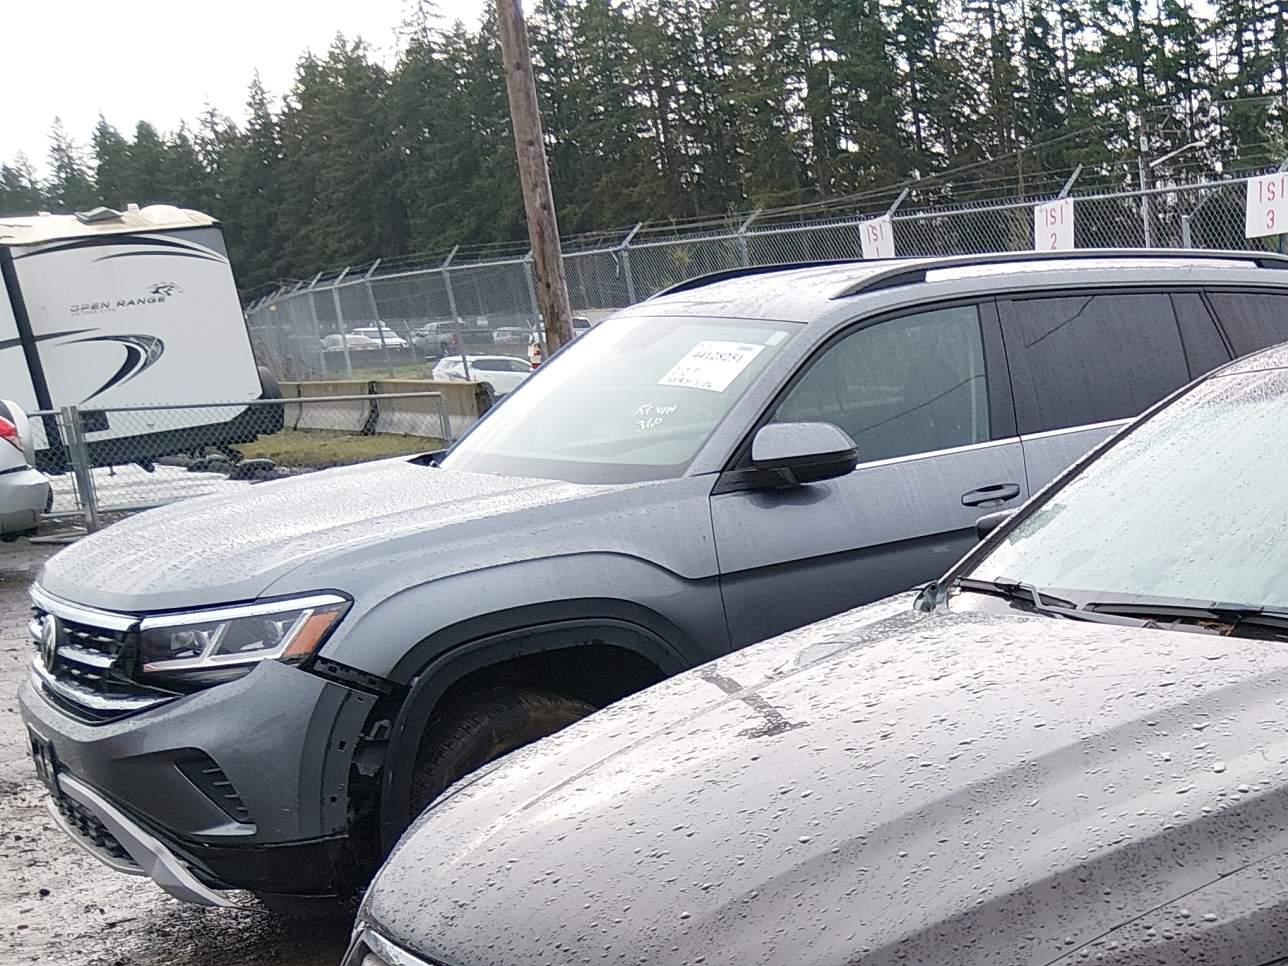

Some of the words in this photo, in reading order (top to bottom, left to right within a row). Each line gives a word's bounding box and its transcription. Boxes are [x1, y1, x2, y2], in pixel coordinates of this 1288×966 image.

[1266, 209, 1276, 230] 3
[1050, 232, 1057, 250] 2
[70, 302, 110, 313] OPEN
[116, 297, 166, 307] RANGE
